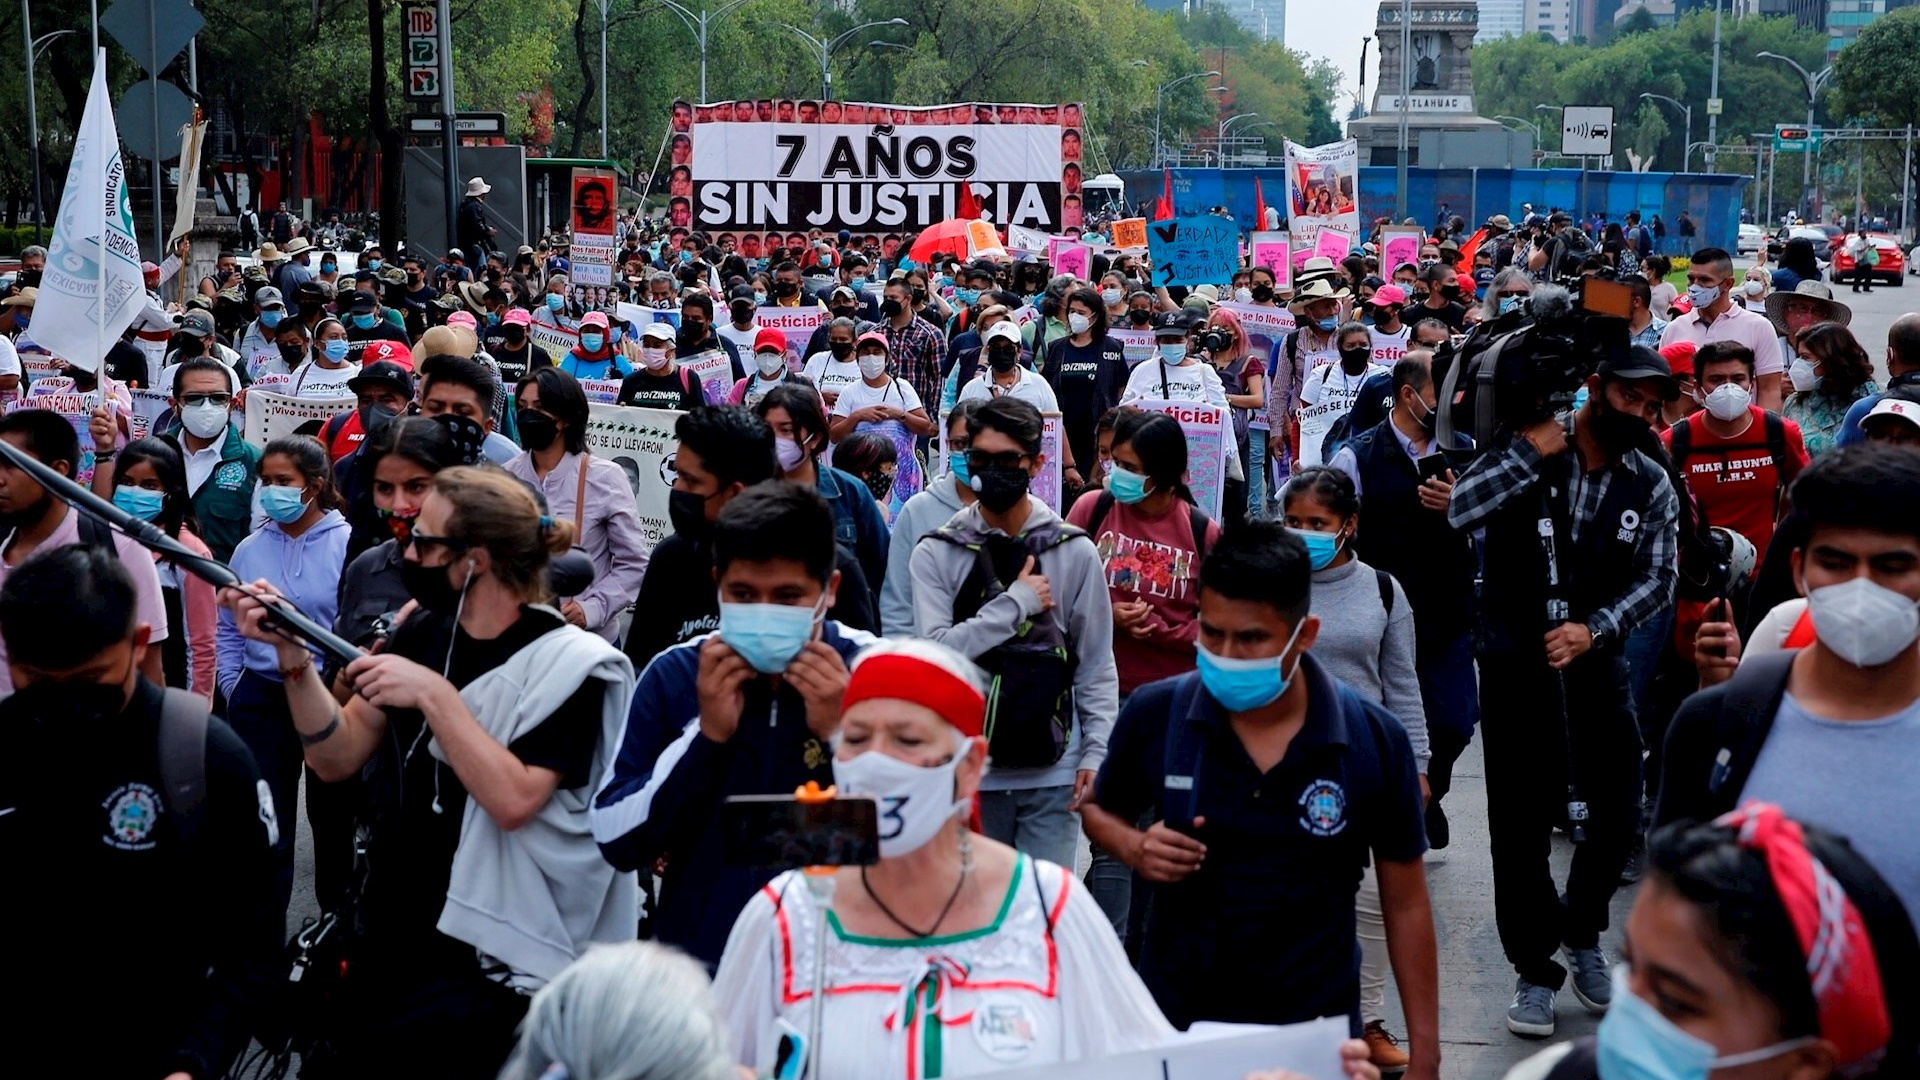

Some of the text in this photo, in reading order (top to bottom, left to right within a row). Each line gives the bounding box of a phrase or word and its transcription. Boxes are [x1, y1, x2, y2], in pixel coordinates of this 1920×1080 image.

[1393, 99, 1458, 108] CTLAHUAC
[434, 121, 476, 129] RRMA
[776, 123, 978, 179] 7 AÑOS
[105, 162, 123, 217] SINDICATO
[698, 181, 1052, 226] SIN JUSTICIA
[1154, 222, 1230, 244] VERDAD
[109, 235, 140, 264] DEMOC
[571, 246, 584, 254] Nos
[585, 247, 604, 256] faltan
[1243, 313, 1297, 327] se lo llevaro
[532, 329, 575, 349] UZGARLOS
[1125, 337, 1146, 345] se lo
[1103, 351, 1121, 361] CIDH
[266, 376, 278, 385] se
[1151, 382, 1201, 393] AYTZINAPA
[36, 395, 54, 412] NOS
[54, 395, 82, 414] FALTAN
[1329, 400, 1342, 411] SE
[309, 410, 319, 419] lo
[600, 435, 609, 448] SE
[611, 436, 622, 449] LO
[624, 438, 664, 455] LLEVARON!
[1691, 456, 1774, 473] MARABUNTA
